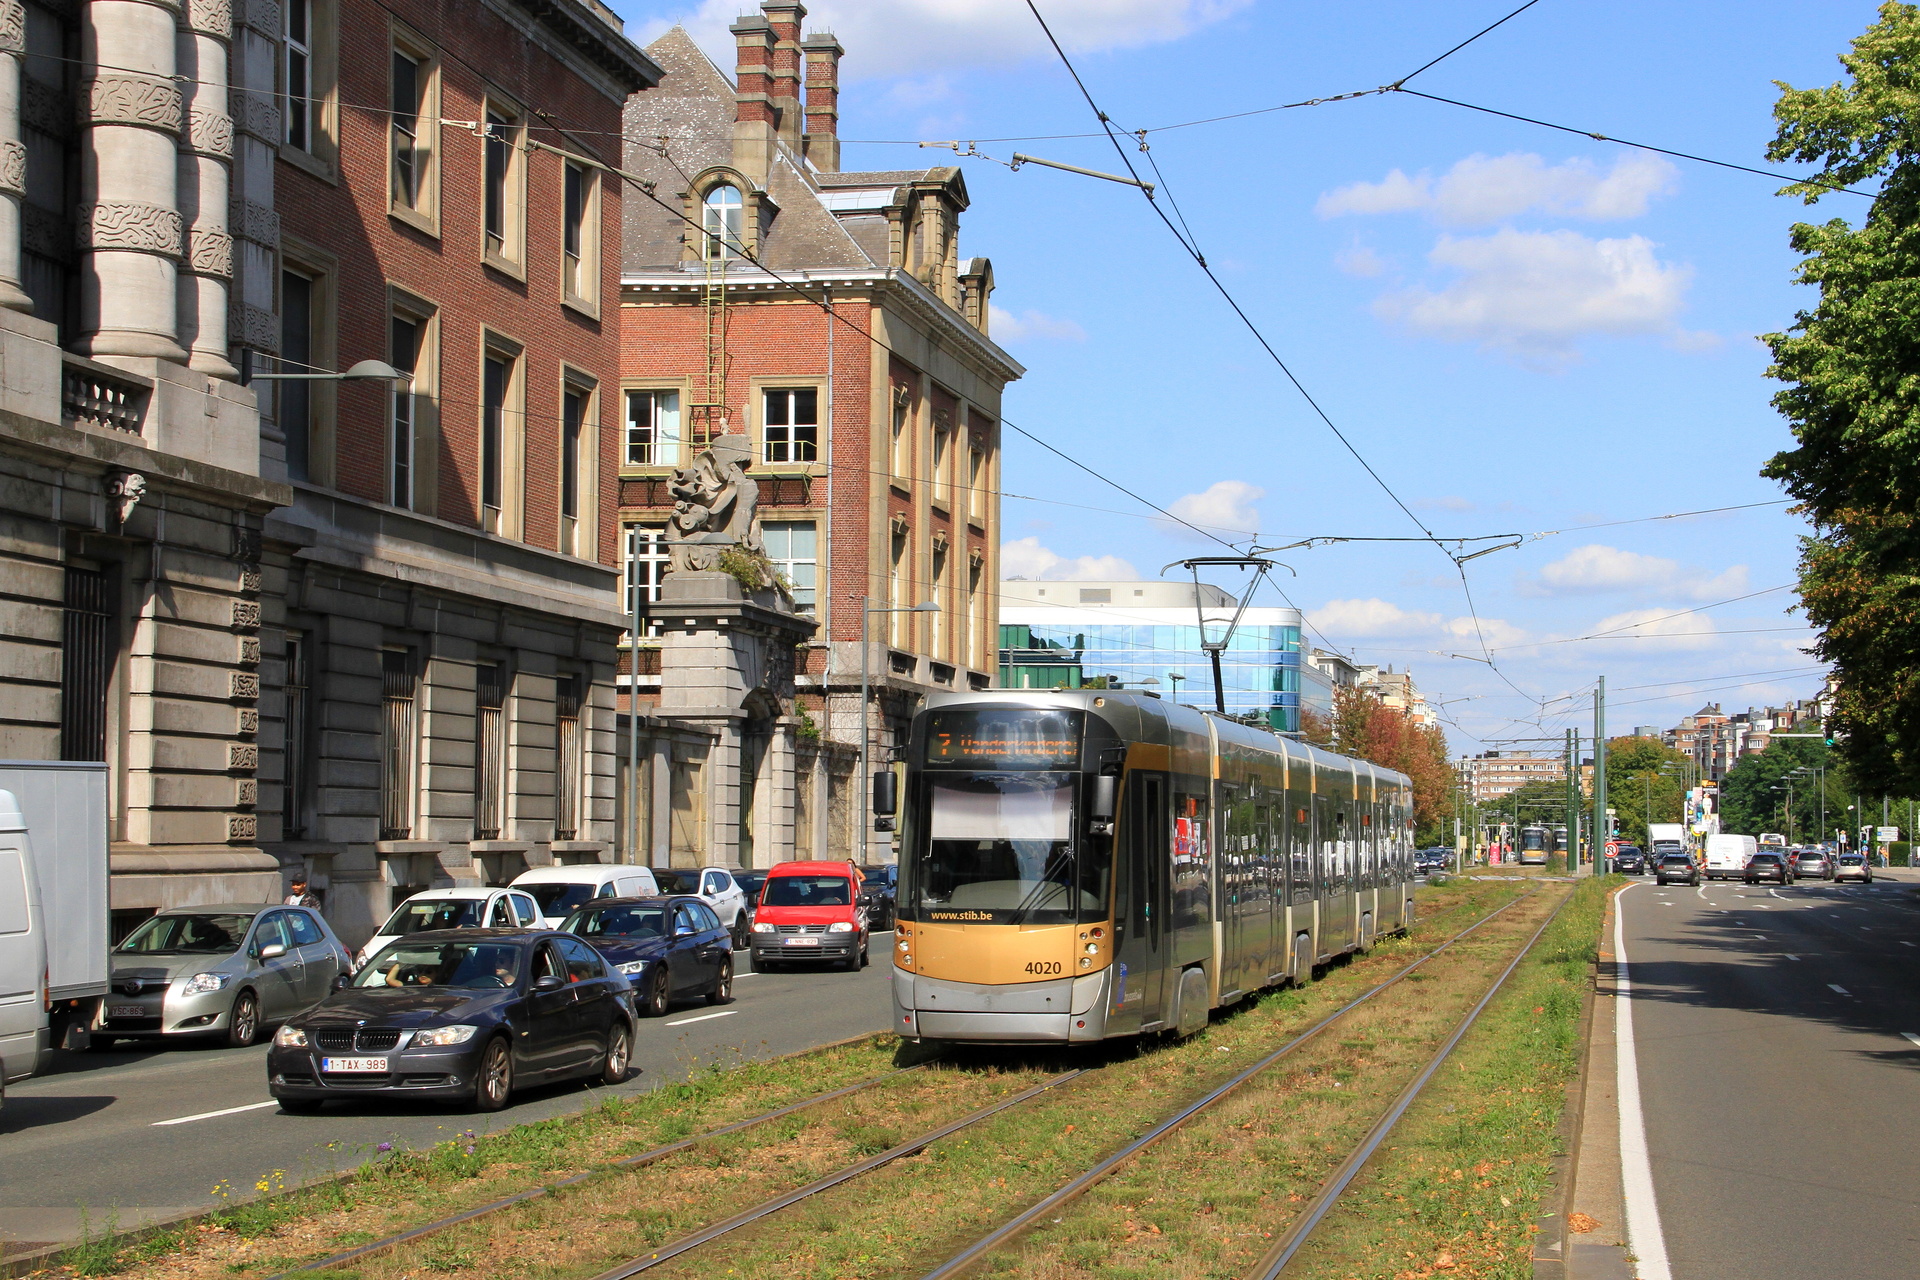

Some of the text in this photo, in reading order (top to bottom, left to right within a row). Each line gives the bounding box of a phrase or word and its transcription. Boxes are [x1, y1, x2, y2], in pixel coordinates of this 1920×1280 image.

[939, 733, 950, 755] 7
[931, 911, 993, 920] www.stib.be
[1025, 961, 1062, 975] 4020
[329, 1059, 386, 1070] 1-TAX-989
